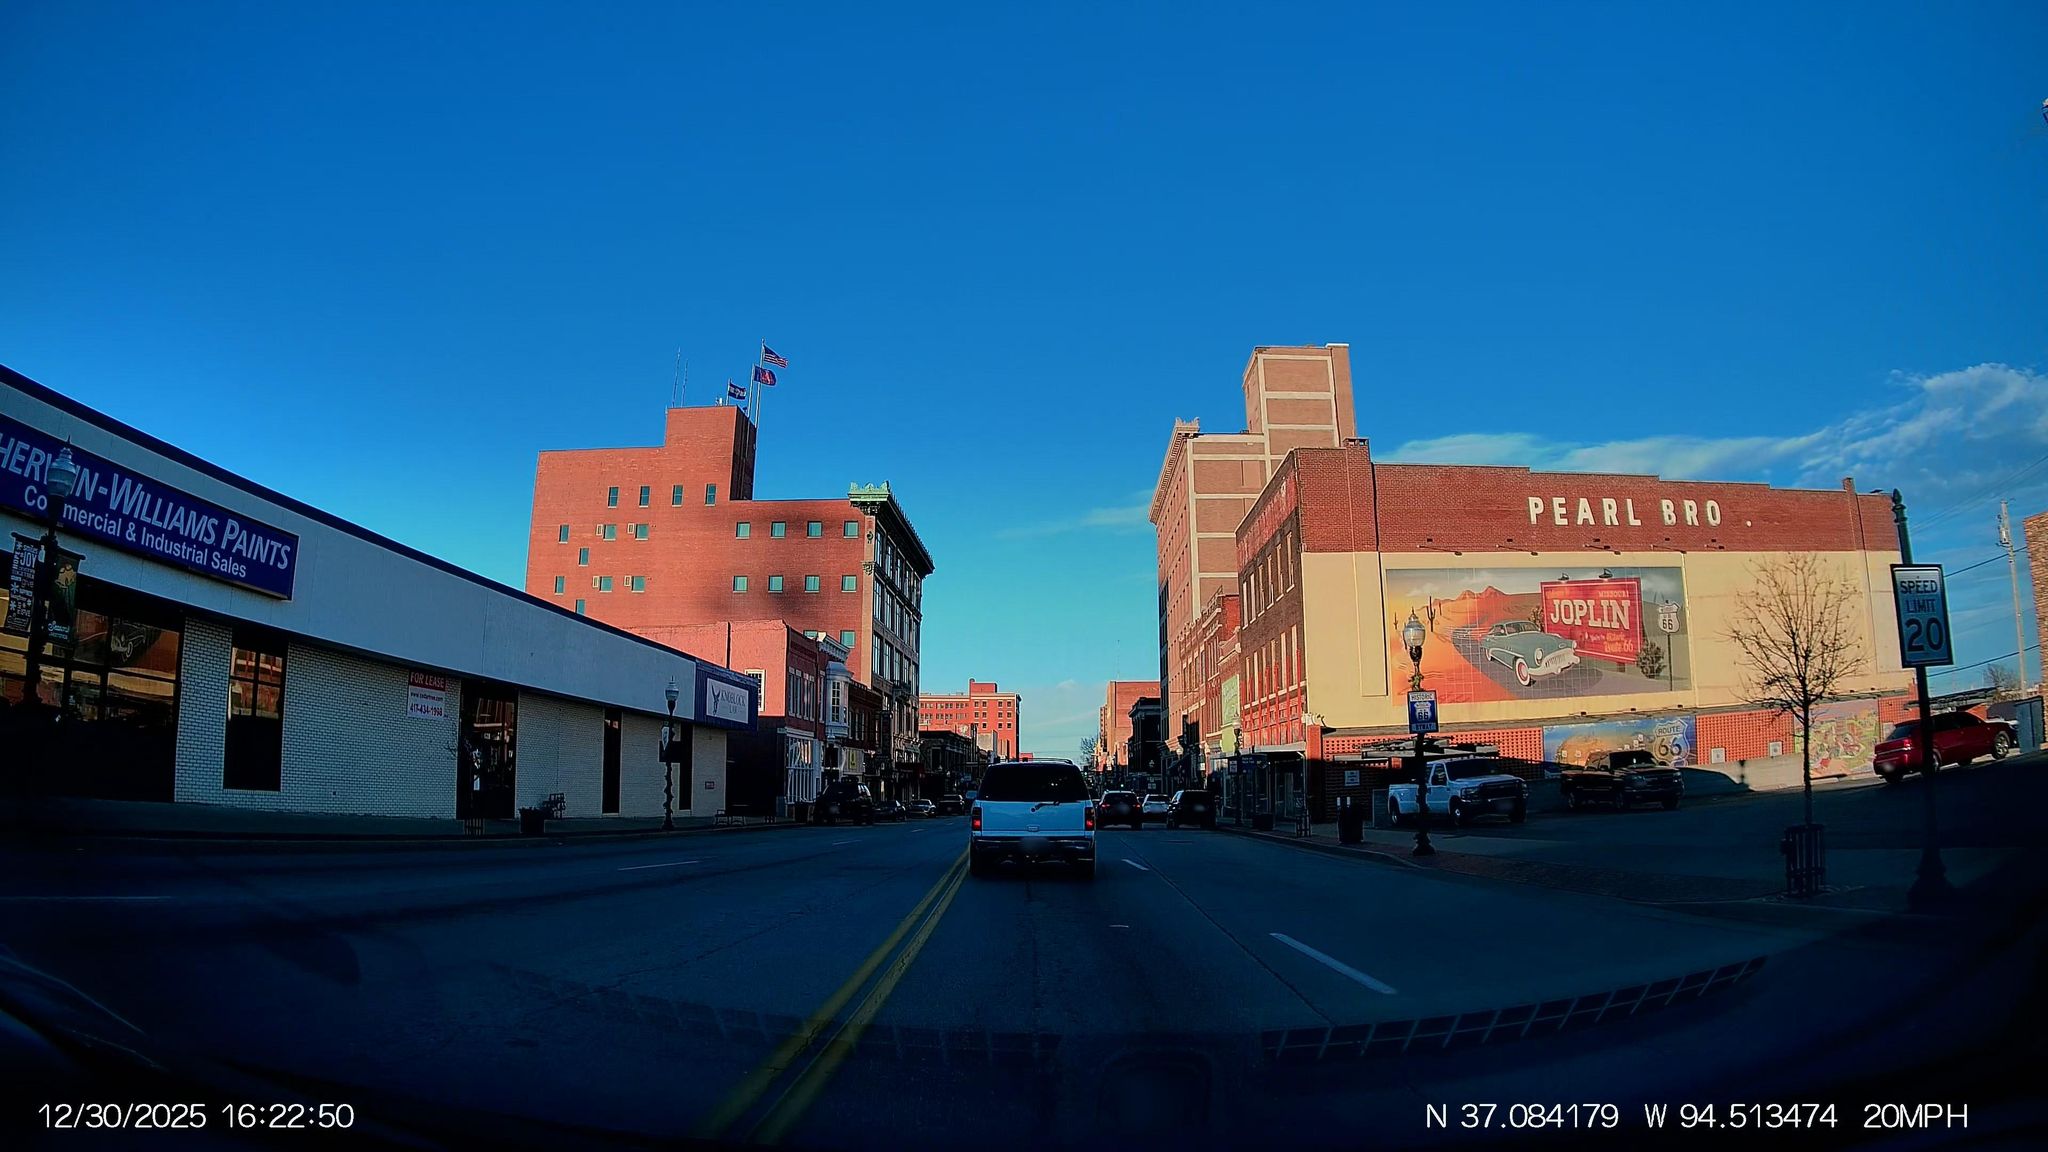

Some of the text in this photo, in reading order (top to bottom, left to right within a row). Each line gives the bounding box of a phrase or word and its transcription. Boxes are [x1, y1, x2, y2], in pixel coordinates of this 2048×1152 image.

[0, 433, 291, 570] HERIN-WILLIAMS PAINTS
[1528, 496, 1722, 527] PEARL BRO
[24, 485, 247, 579] Comercial & Industrial Sales
[20, 550, 37, 569] JOY
[1900, 579, 1938, 594] SPEED
[1905, 598, 1937, 614] LIMIT
[1550, 599, 1631, 631] JOPLIN
[1662, 618, 1674, 631] 66
[1905, 617, 1944, 652] 20
[1623, 640, 1634, 653] 66
[410, 672, 444, 688] FOR LEASE
[1418, 711, 1429, 720] 66
[1658, 726, 1681, 735] ROUTE
[1659, 737, 1683, 756] 66
